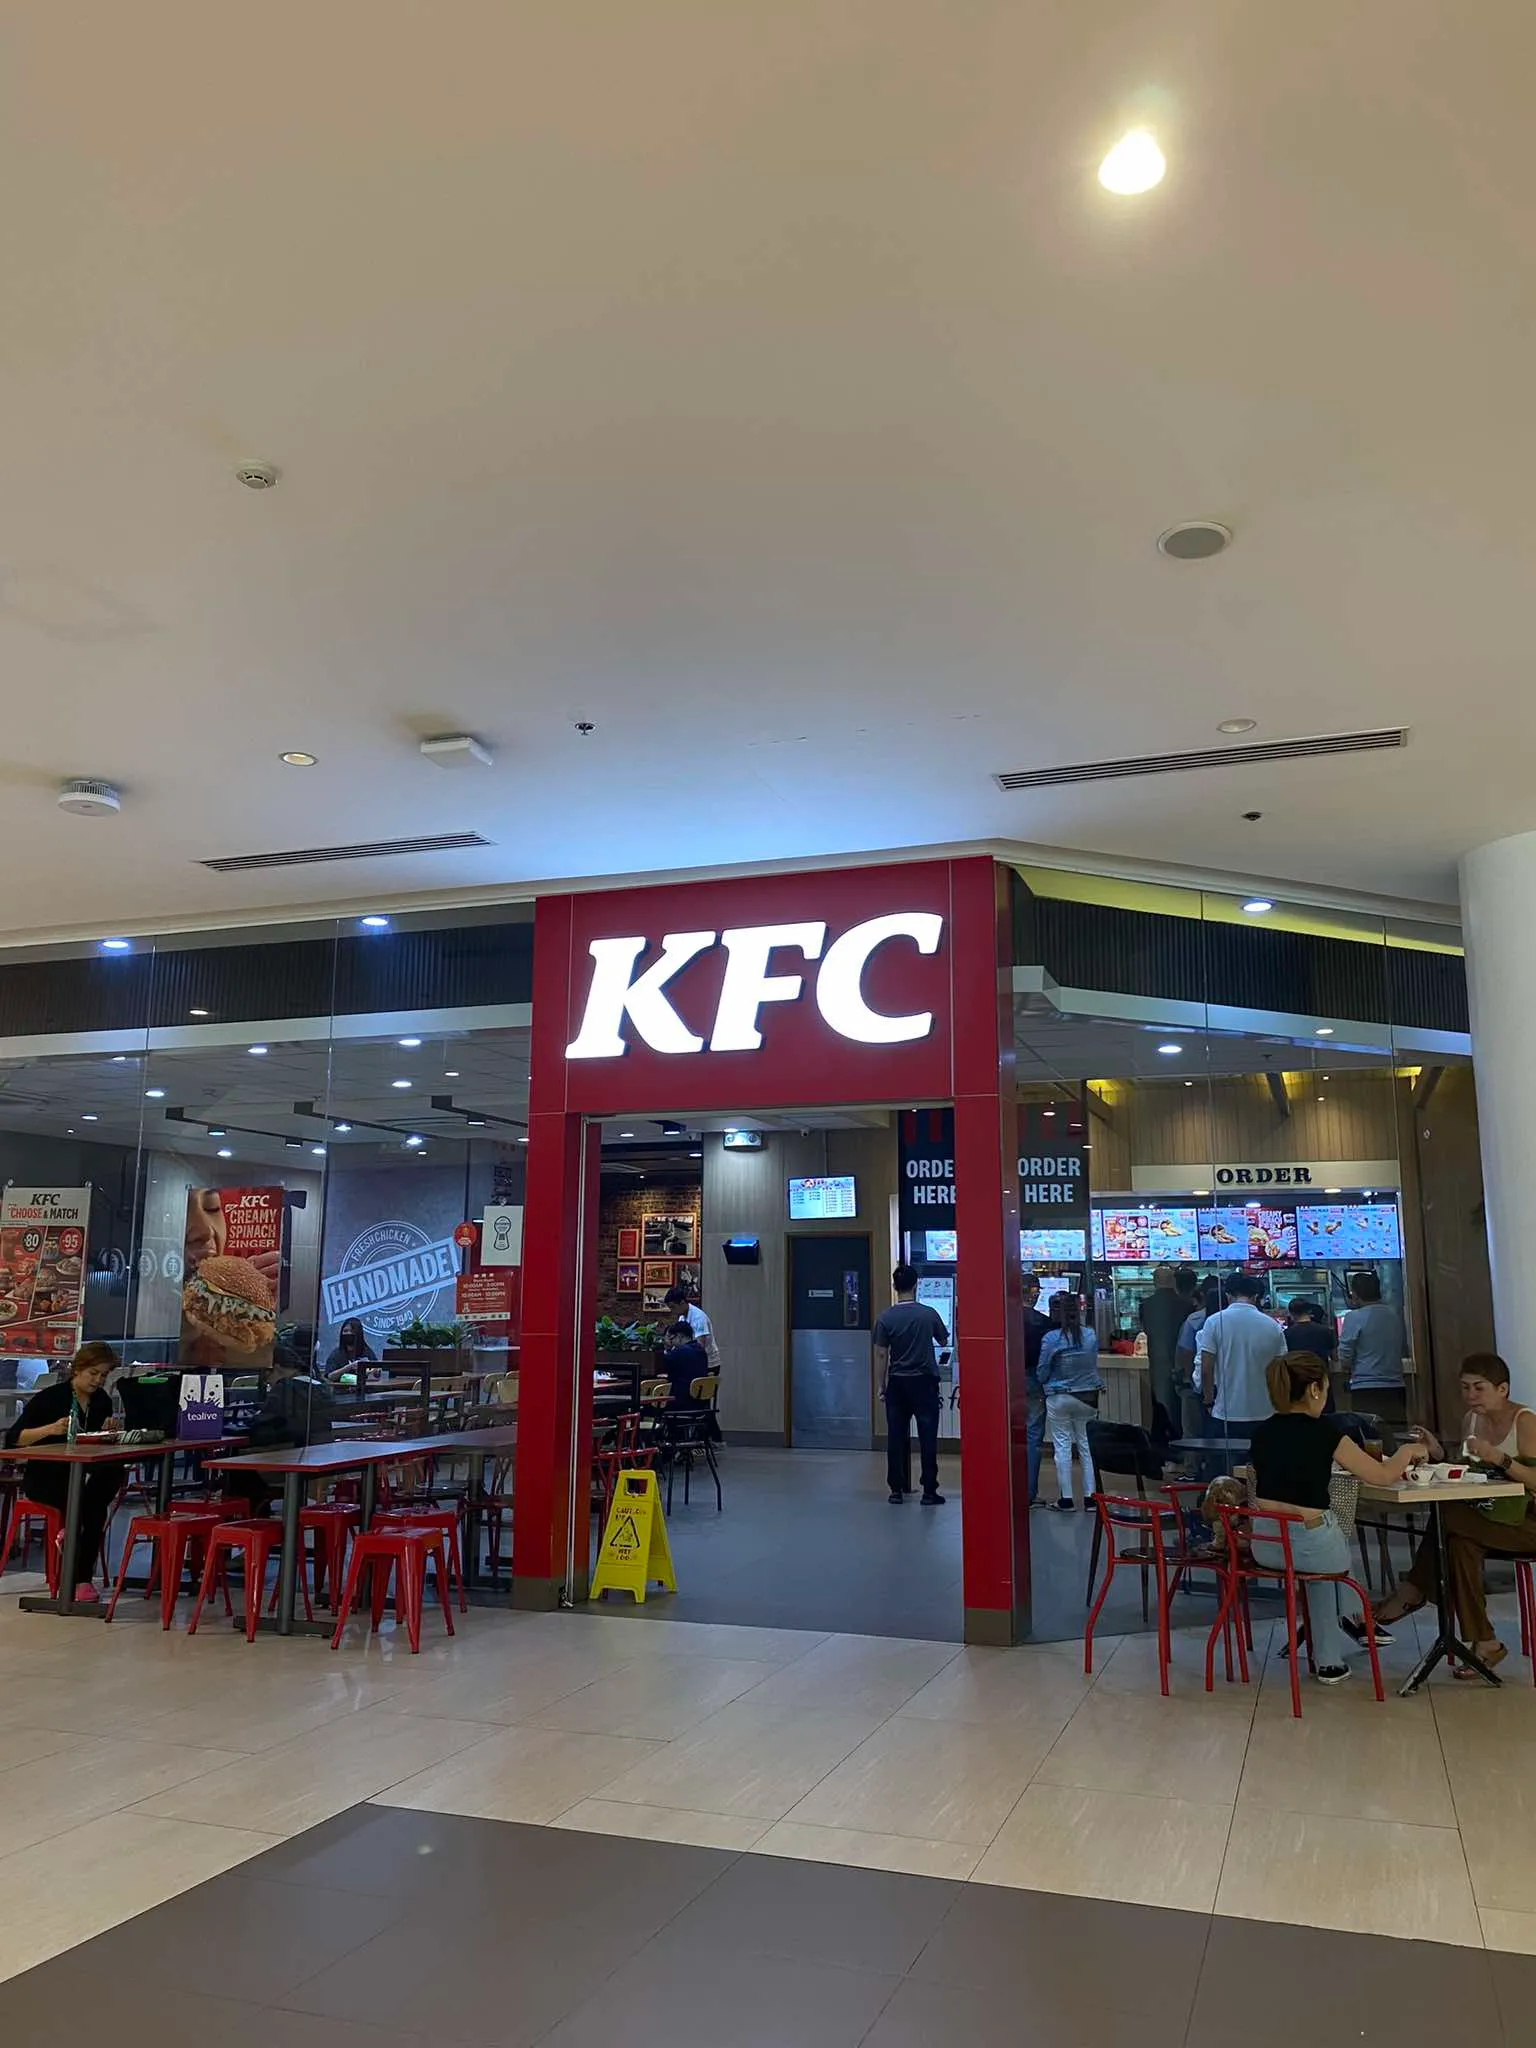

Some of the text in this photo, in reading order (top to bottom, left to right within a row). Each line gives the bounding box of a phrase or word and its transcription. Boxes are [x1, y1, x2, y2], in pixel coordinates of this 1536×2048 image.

[565, 912, 943, 1059] KFC
[906, 1159, 954, 1178] ORDE
[1018, 1157, 1080, 1177] ORDER
[1216, 1167, 1312, 1184] ORDER
[30, 1193, 60, 1206] KFC
[1024, 1183, 1074, 1203] HERE
[239, 1195, 270, 1208] KFC
[10, 1207, 42, 1219] CHOOSE
[50, 1207, 79, 1219] MATCH
[229, 1208, 277, 1224] CREAMY
[228, 1224, 276, 1238] SPINACH
[227, 1240, 275, 1249] ZINGER
[351, 1229, 413, 1262] FRESH CHICKEN
[329, 1247, 451, 1315] HANDMADE
[373, 1316, 395, 1329] SINCE
[187, 1412, 218, 1421] tealive
